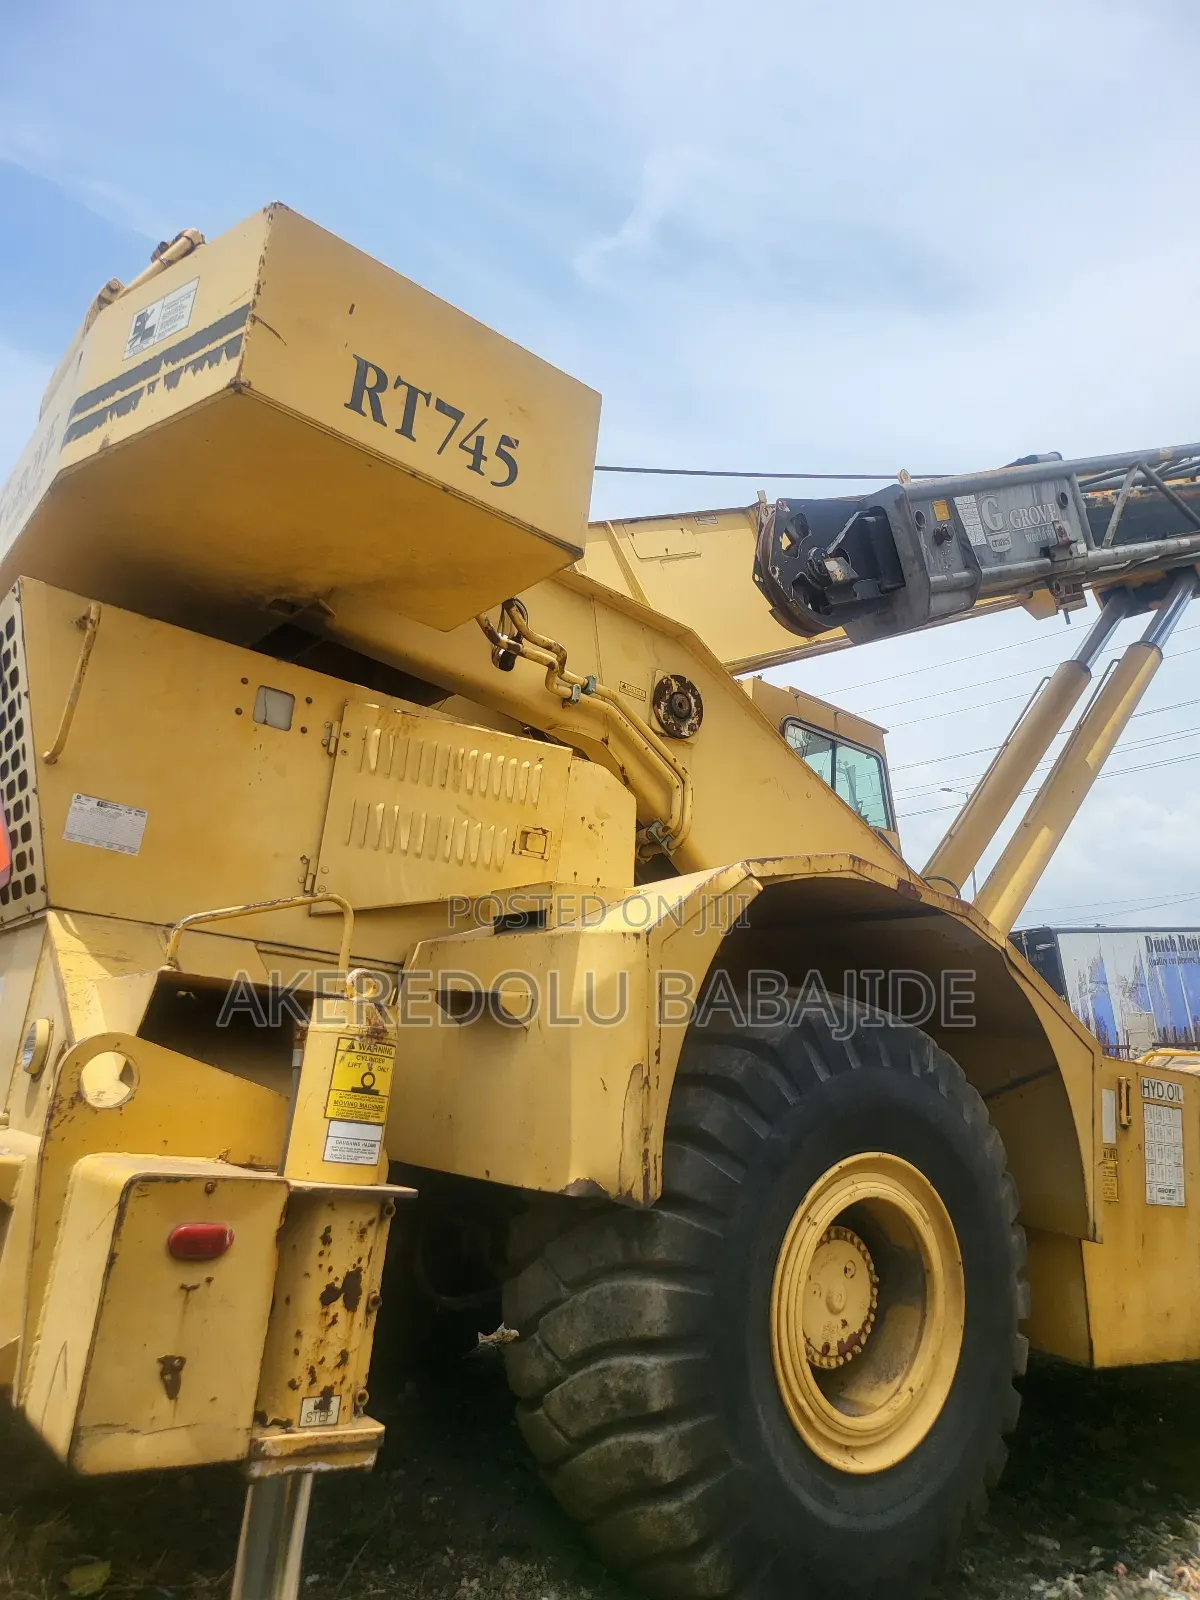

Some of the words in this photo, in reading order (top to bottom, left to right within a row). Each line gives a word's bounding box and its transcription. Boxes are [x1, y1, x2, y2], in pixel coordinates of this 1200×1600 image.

[343, 353, 520, 487] RT745
[1009, 503, 1059, 529] GROVE
[991, 538, 1010, 548] cranes
[1144, 934, 1177, 952] Dutch
[359, 1043, 393, 1056] WARNING
[347, 1061, 362, 1069] LIFT
[356, 1055, 386, 1064] CYLINDER
[333, 1100, 358, 1108] MOVING
[305, 1410, 334, 1424] STEP
